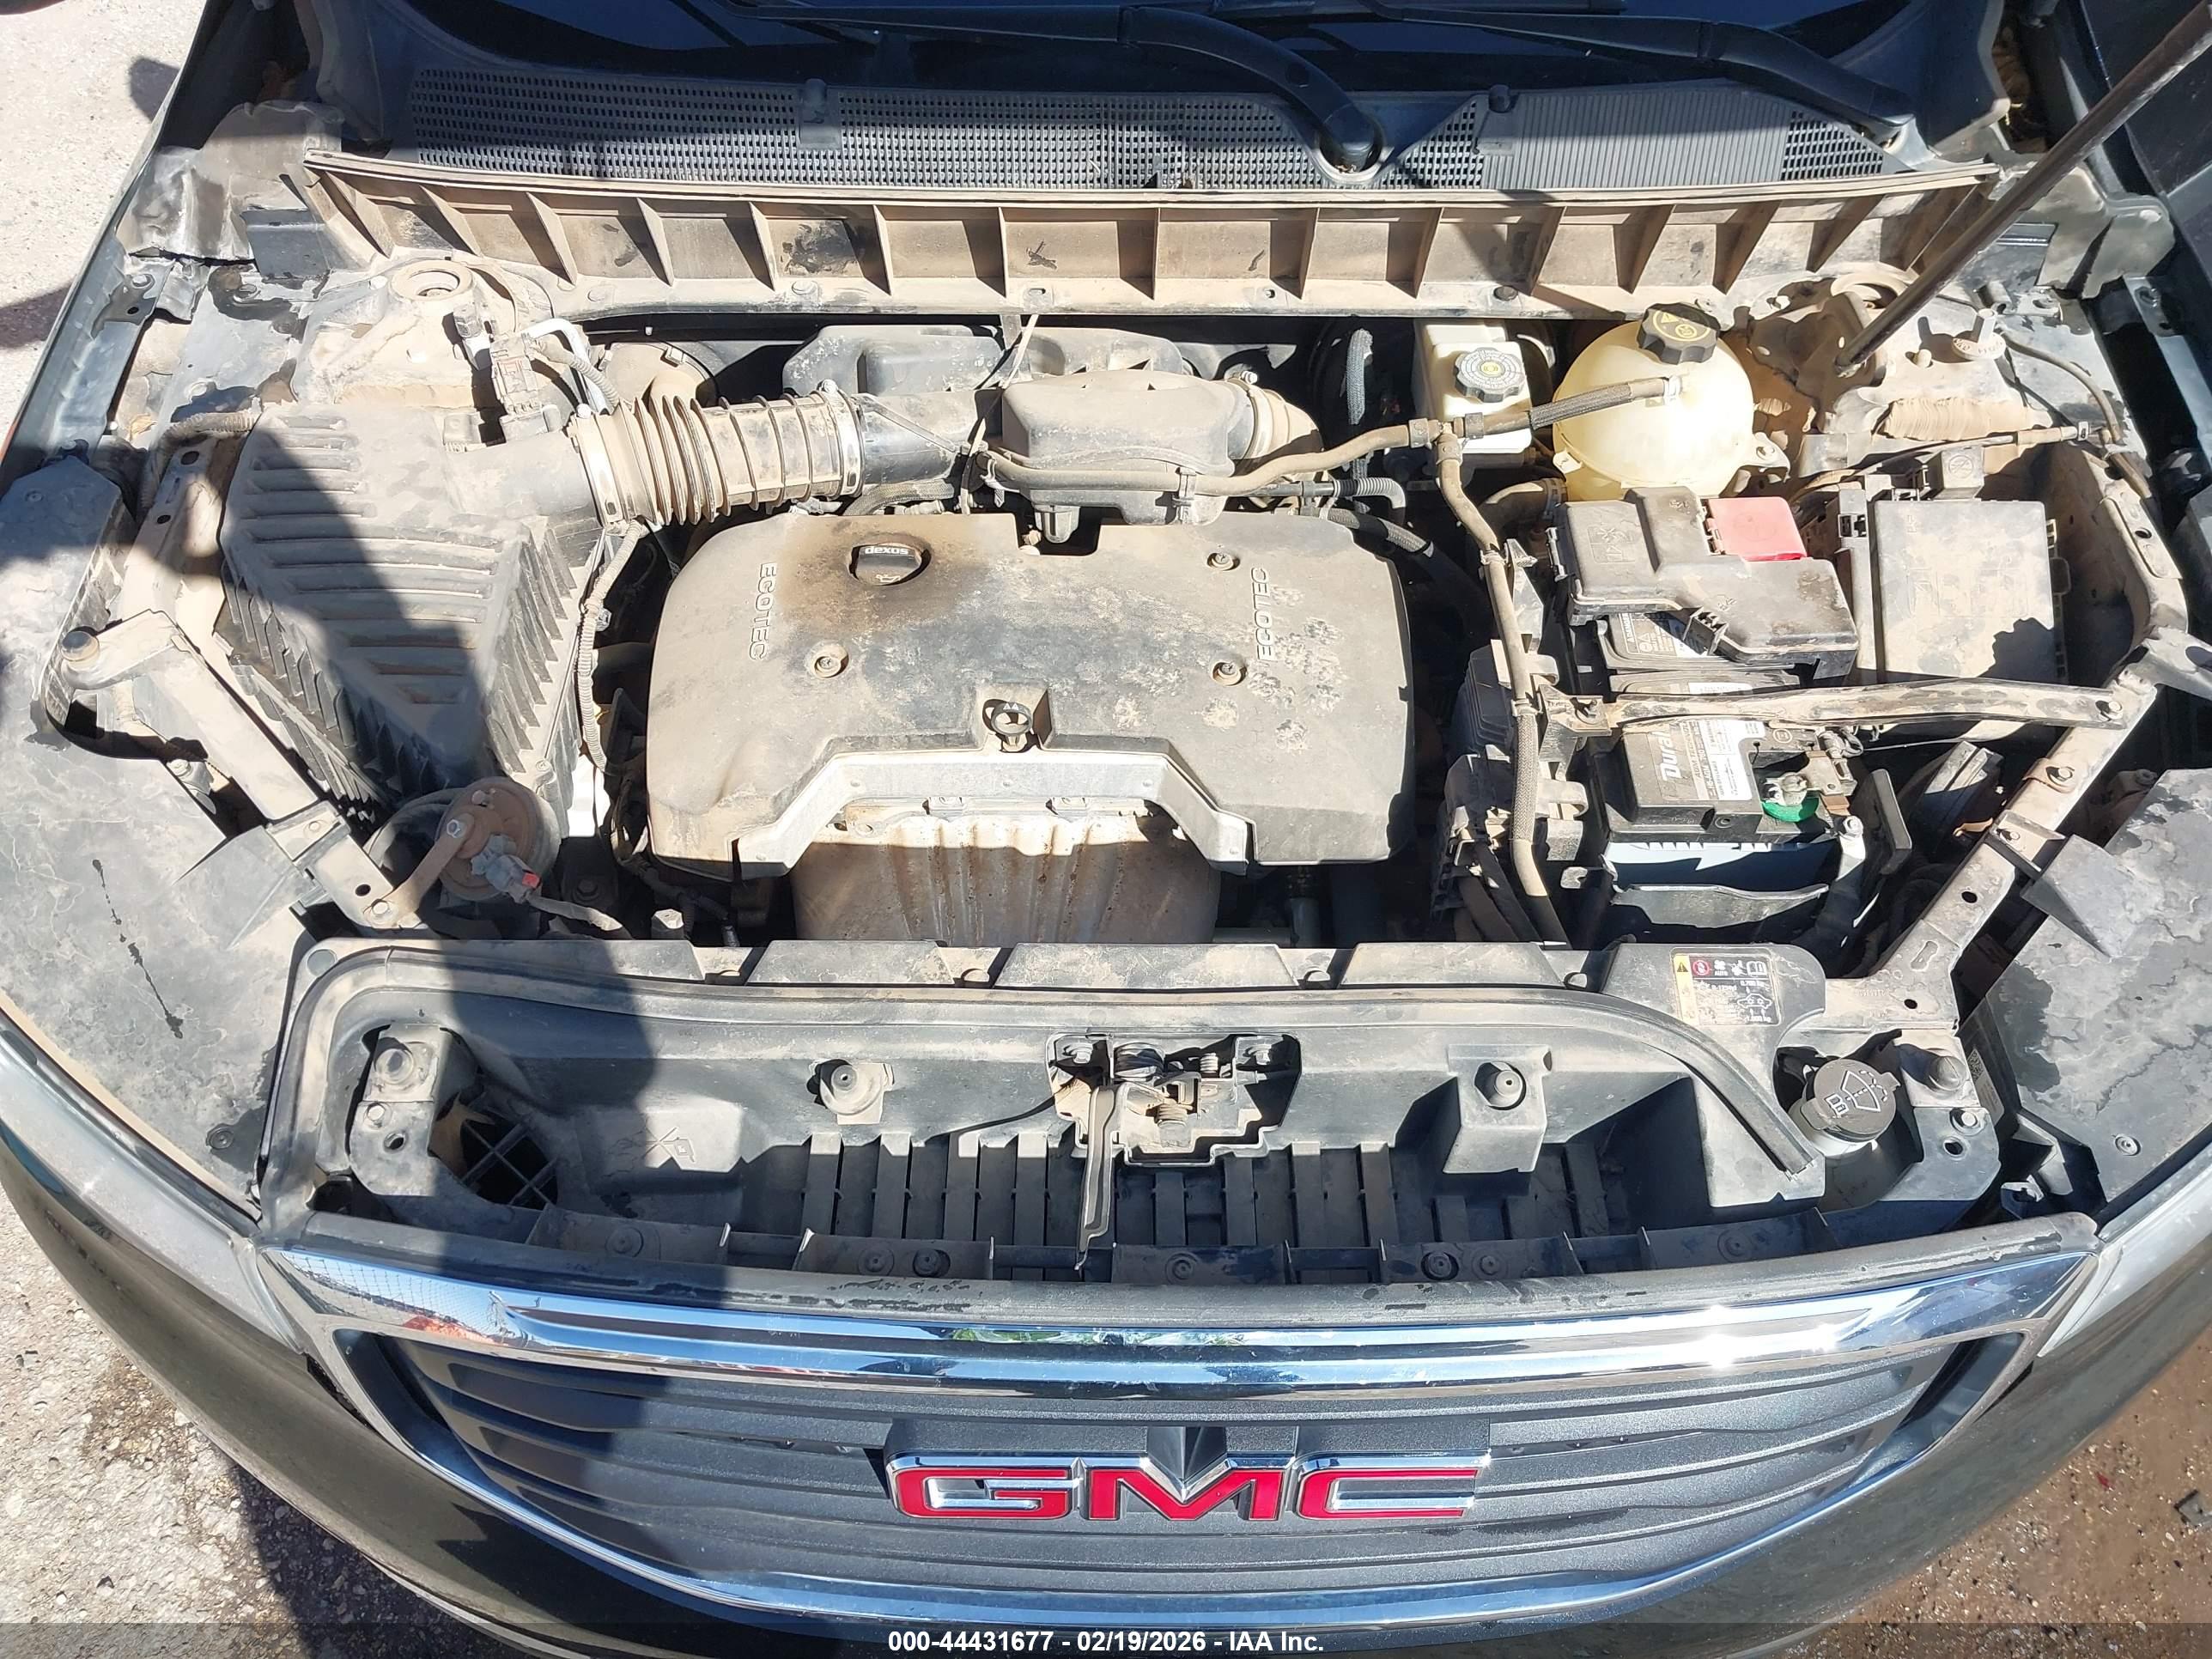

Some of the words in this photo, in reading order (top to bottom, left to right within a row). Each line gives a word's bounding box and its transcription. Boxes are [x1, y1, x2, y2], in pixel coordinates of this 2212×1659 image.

[864, 545, 909, 556] dexos
[748, 561, 778, 660] ECOTEC
[1250, 567, 1278, 663] ECOTEC
[886, 1451, 1491, 1522] GMC
